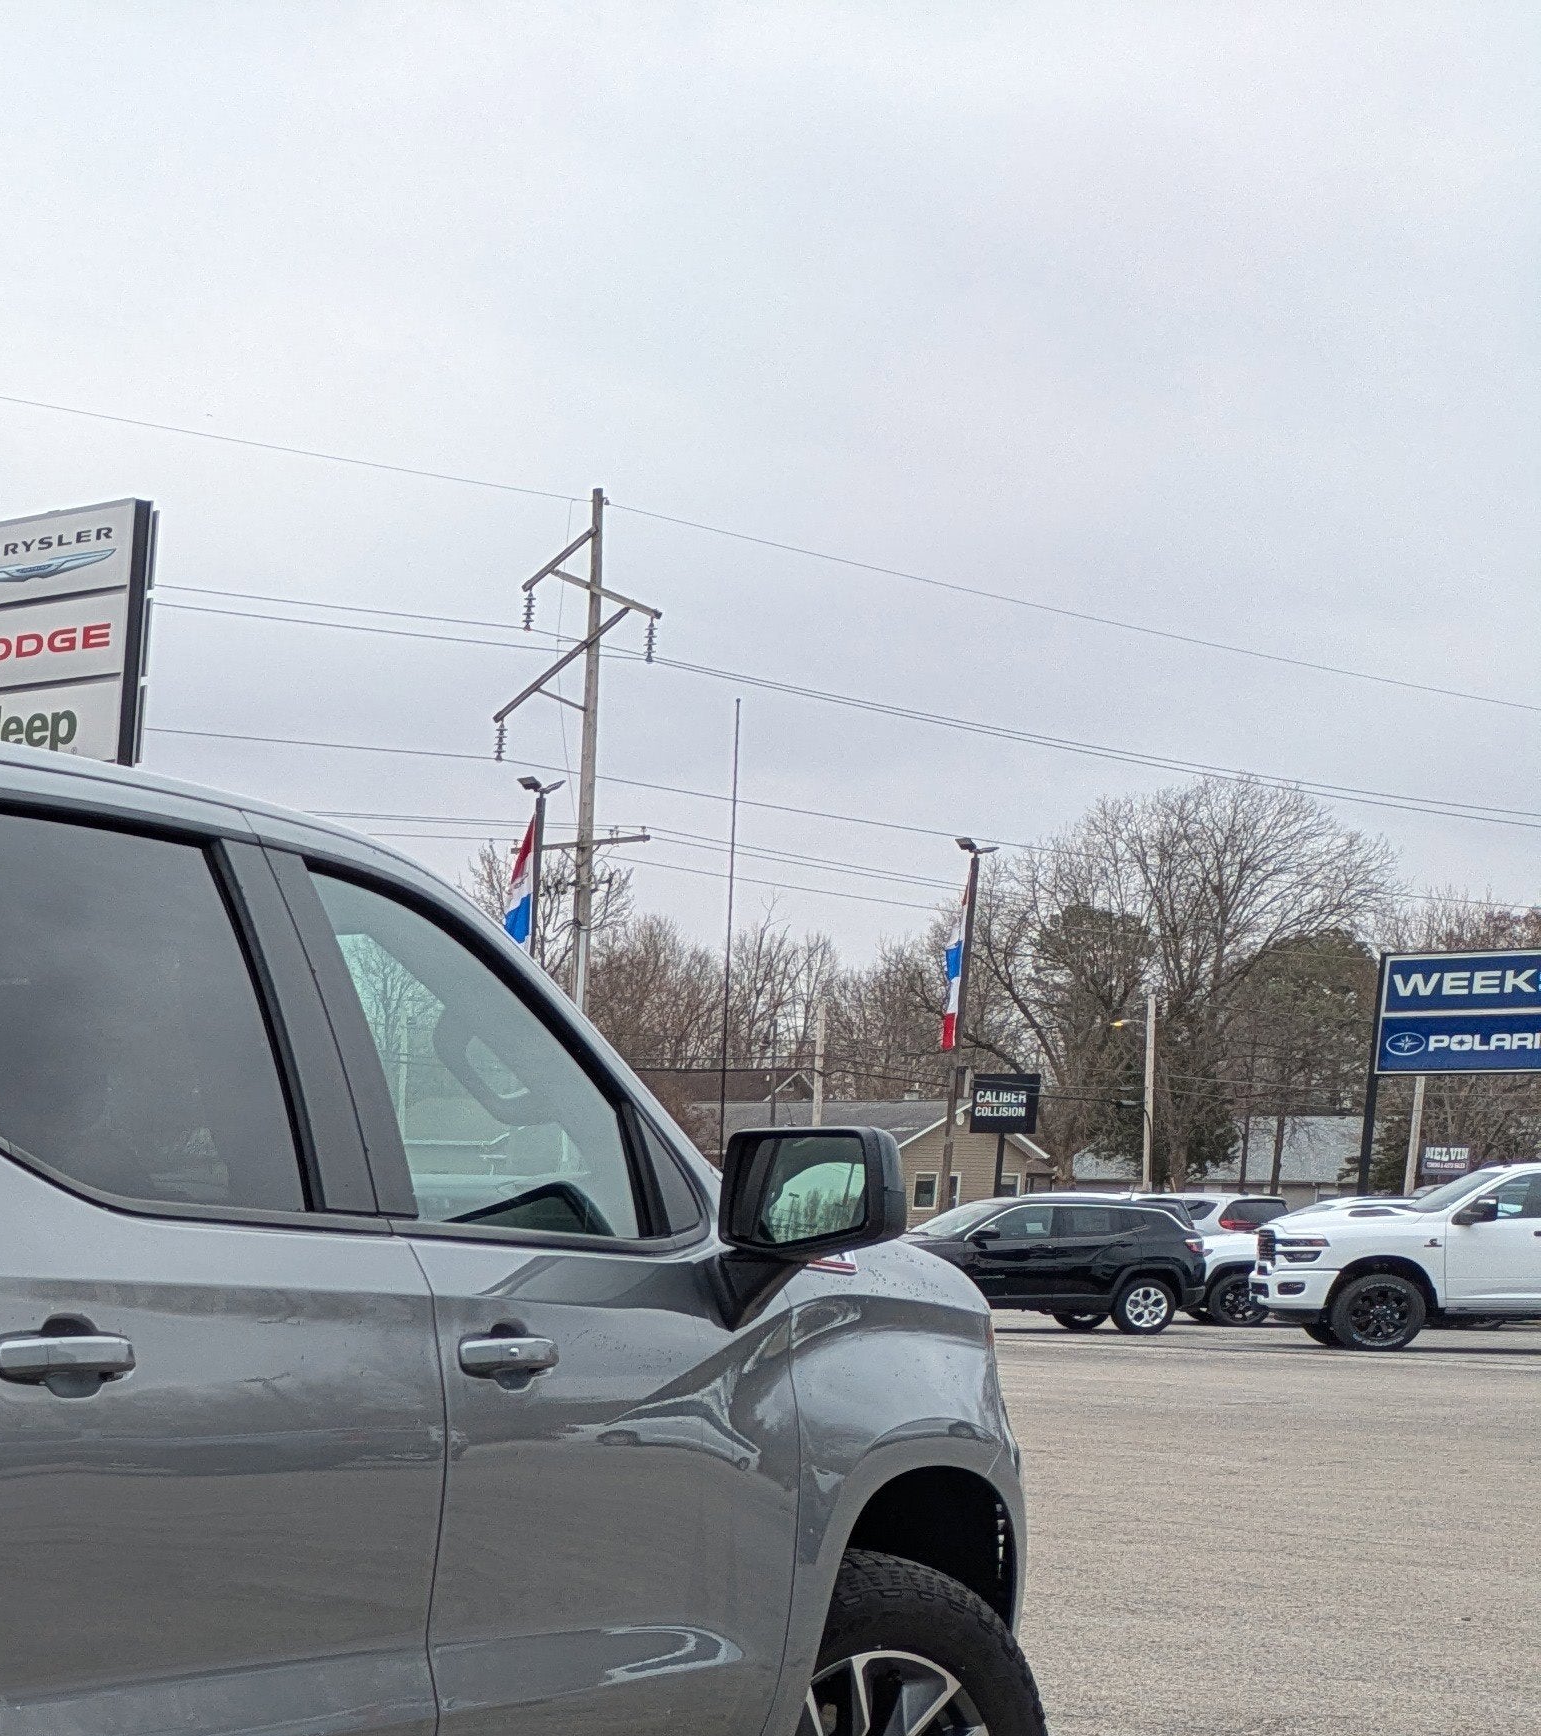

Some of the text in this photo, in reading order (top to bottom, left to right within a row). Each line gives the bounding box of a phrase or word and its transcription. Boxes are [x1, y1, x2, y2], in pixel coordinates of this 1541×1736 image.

[1392, 968, 1541, 997] WEEK
[976, 1091, 1027, 1103] CALIBER
[974, 1106, 1026, 1117] COLLISION
[1424, 1146, 1469, 1161] MELVIN
